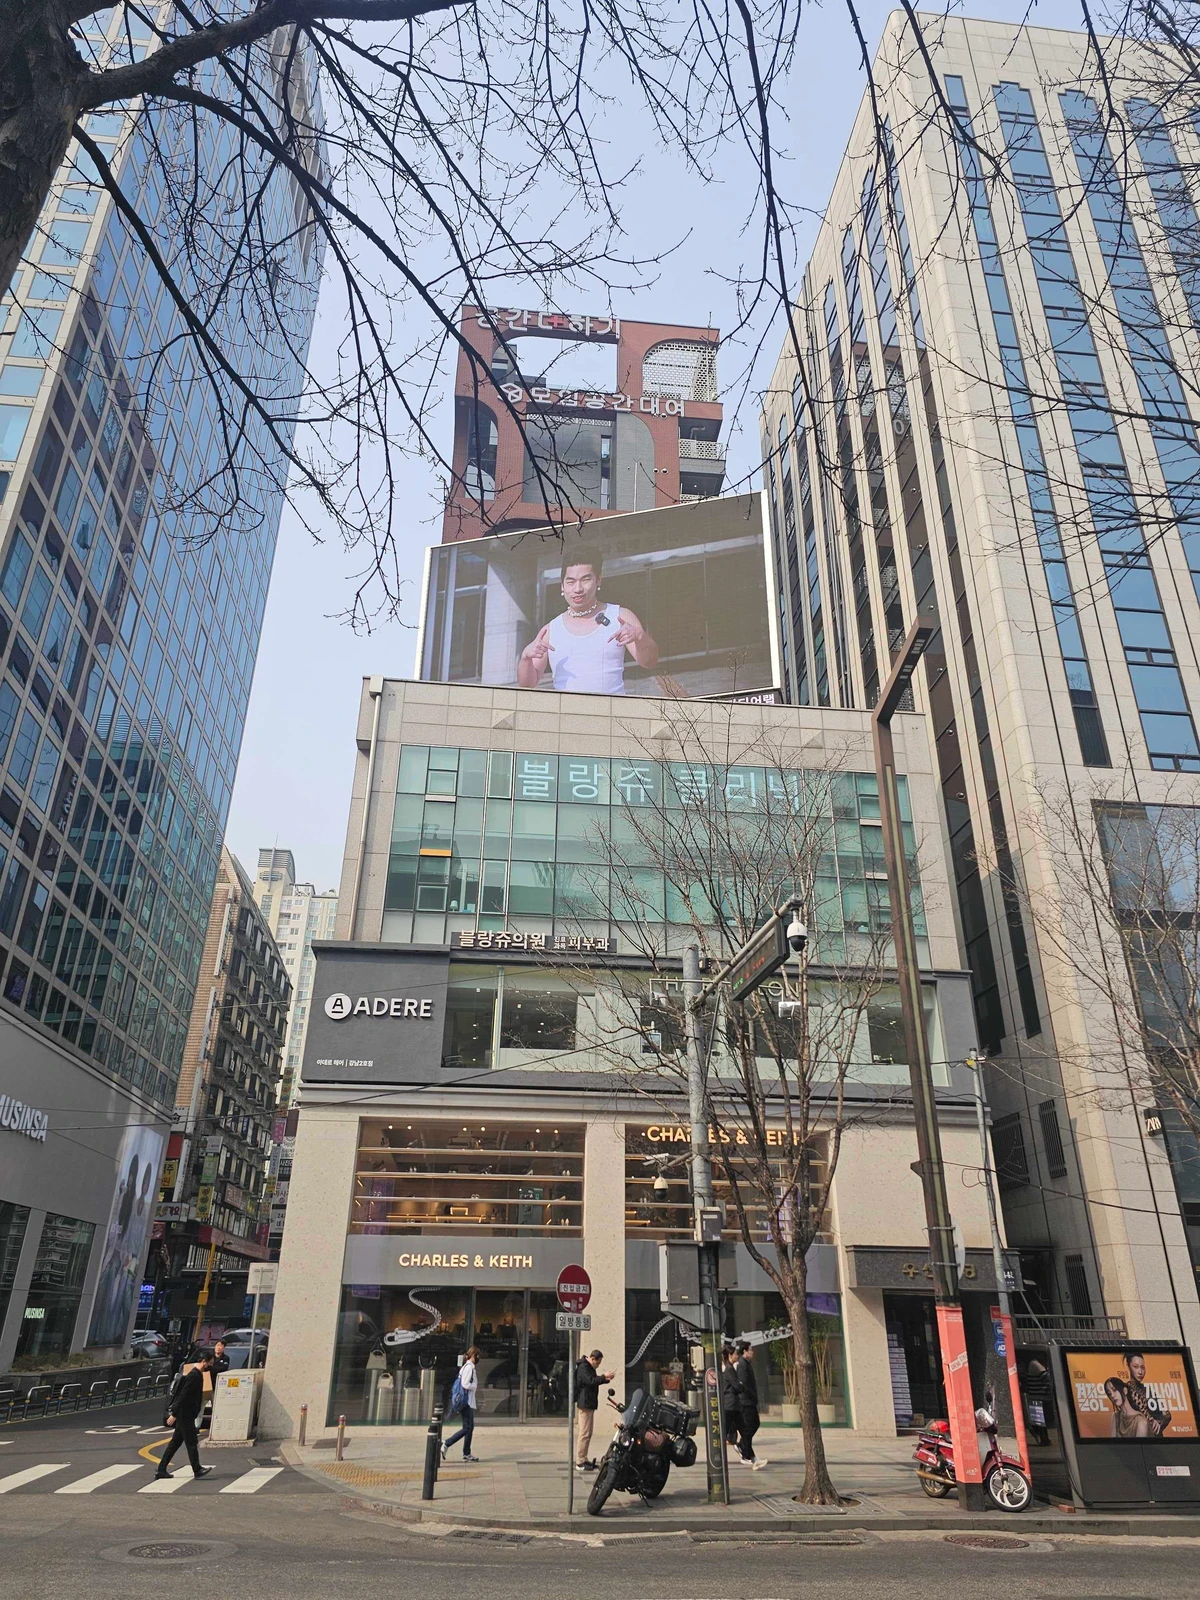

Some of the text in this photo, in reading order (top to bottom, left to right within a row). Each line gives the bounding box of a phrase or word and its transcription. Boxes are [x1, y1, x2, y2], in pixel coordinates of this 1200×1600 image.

[568, 937, 610, 951] 피부과
[353, 997, 433, 1017] ADERE
[399, 1253, 533, 1269] CHARLES & KEITH
[562, 1284, 588, 1293] 진입금지
[559, 1315, 591, 1329] 일방통행
